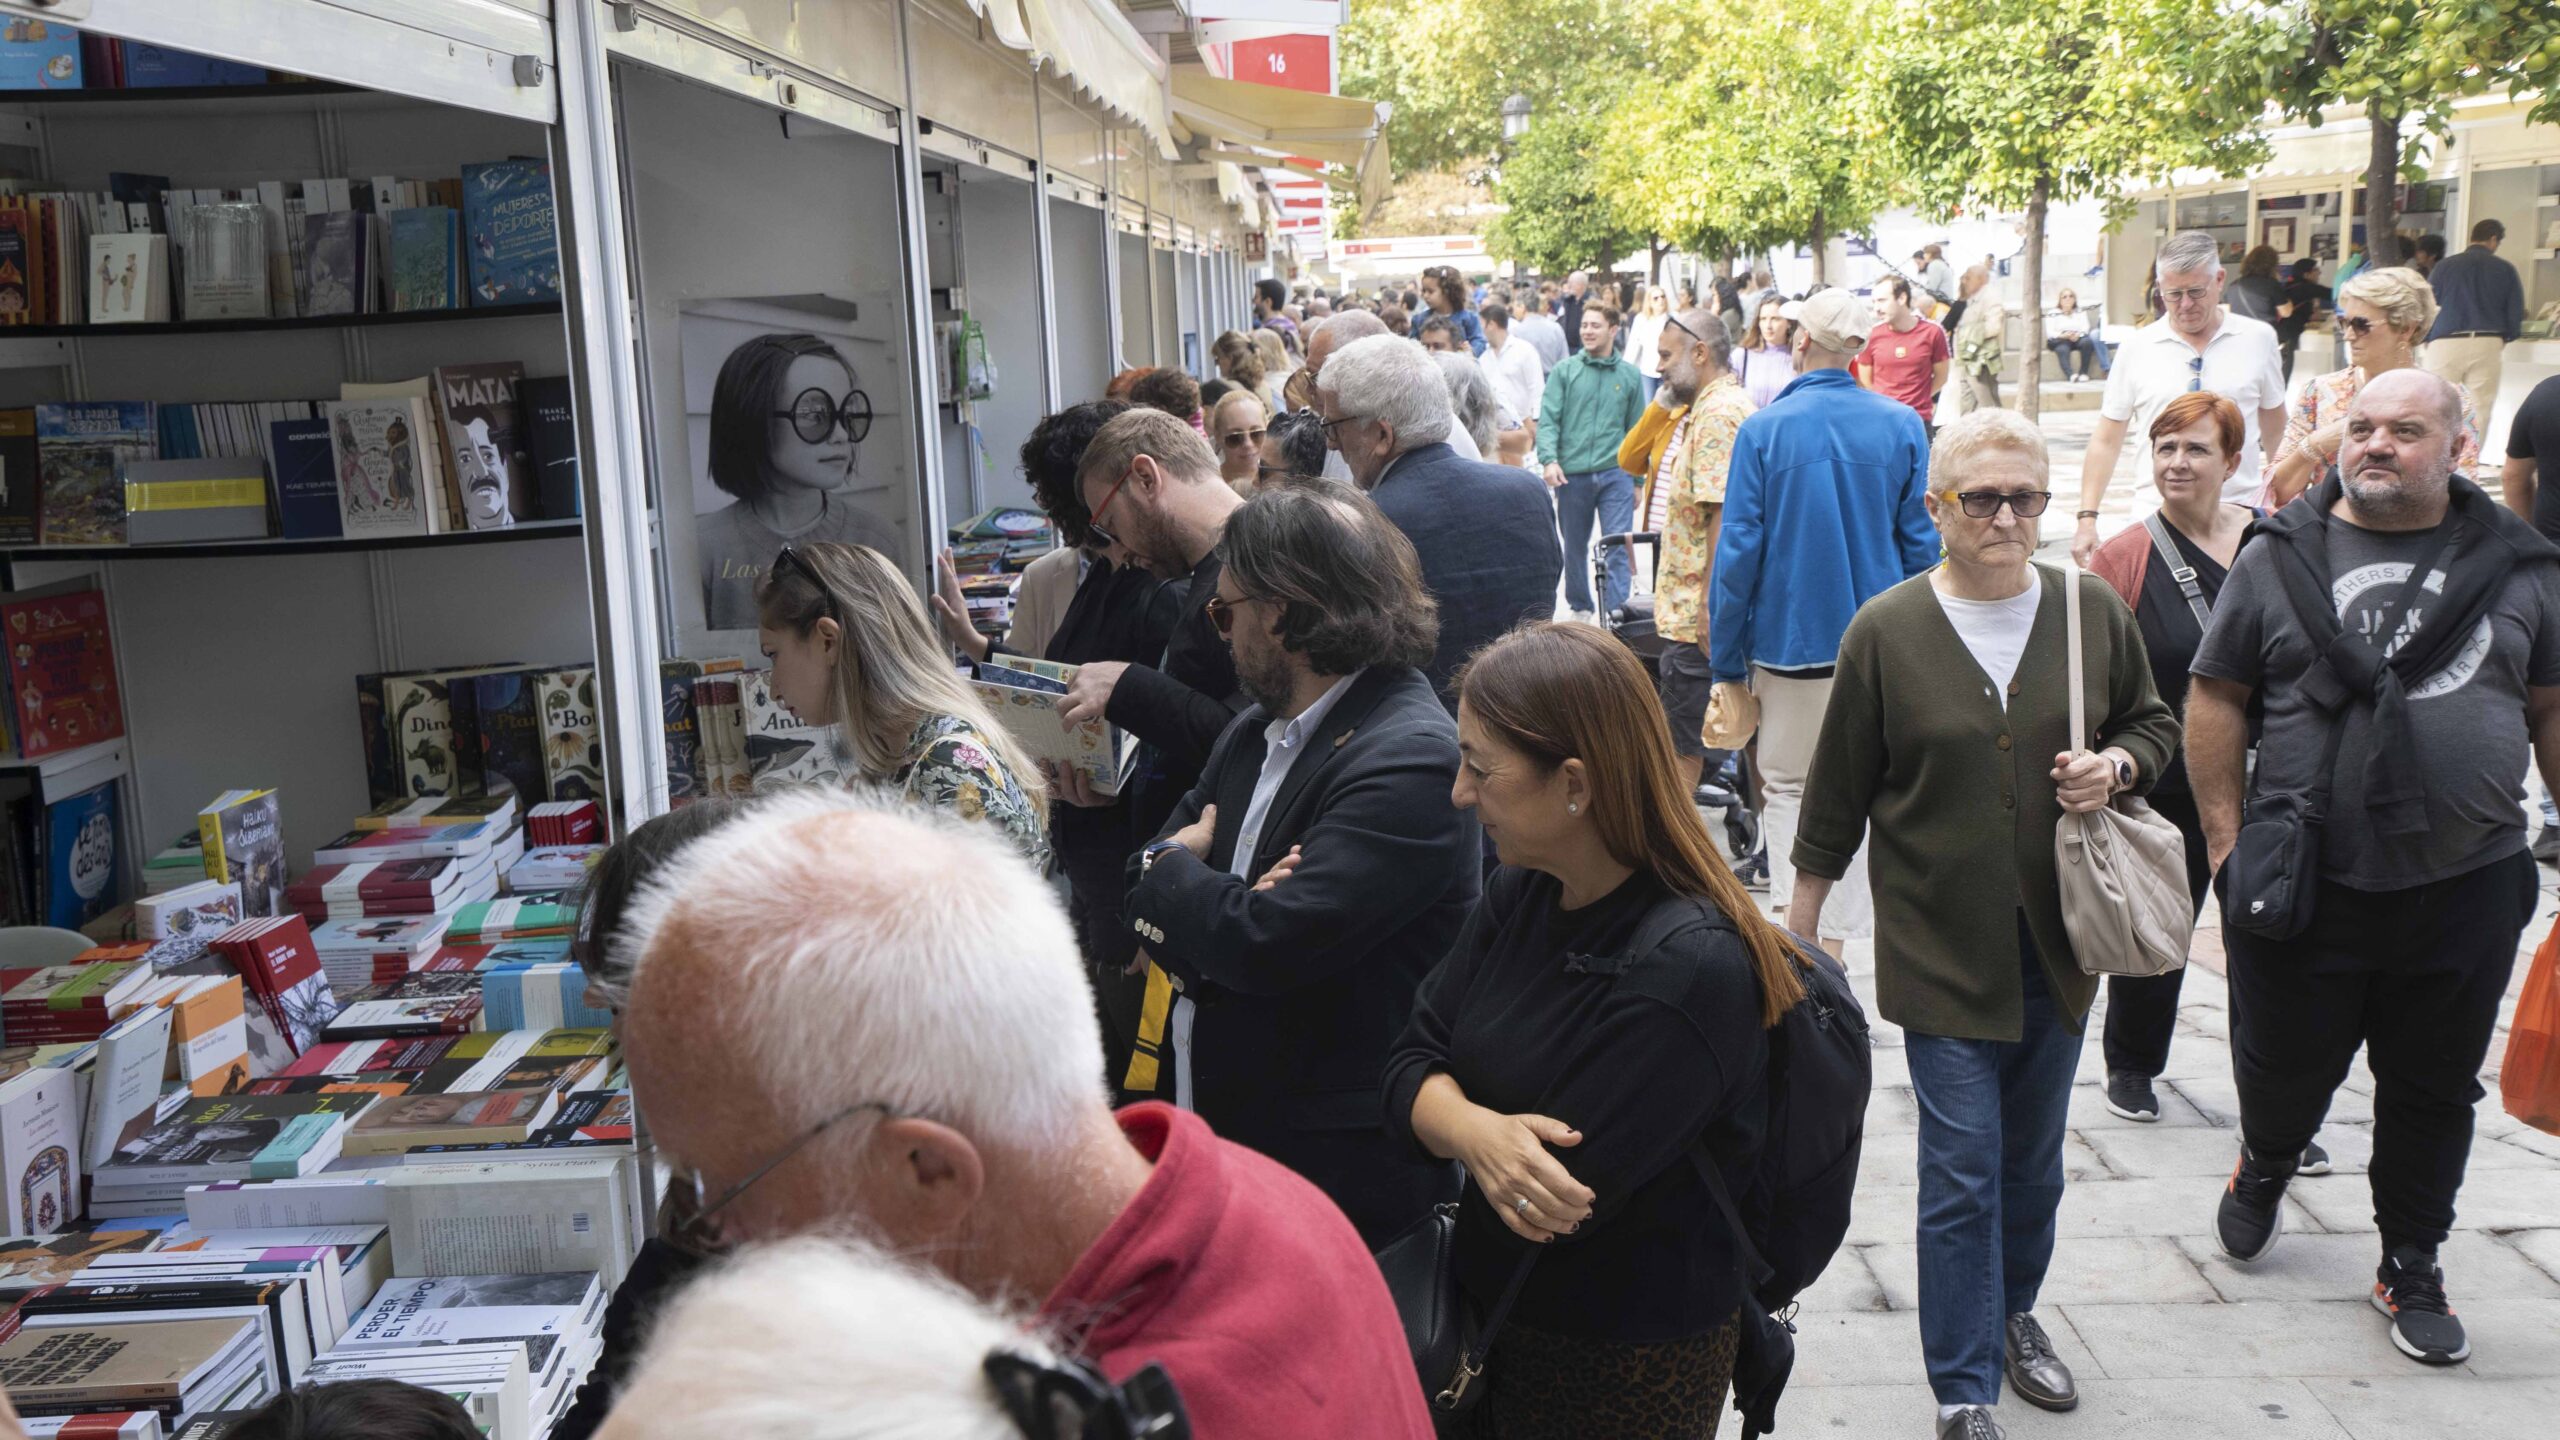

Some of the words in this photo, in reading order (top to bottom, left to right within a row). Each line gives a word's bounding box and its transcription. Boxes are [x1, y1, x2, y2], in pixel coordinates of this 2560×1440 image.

[1268, 53, 1286, 74] 16
[493, 193, 542, 217] MUJERES
[721, 558, 761, 579] Las
[2414, 660, 2472, 694] WEAR
[411, 716, 453, 734] Din
[561, 710, 597, 729] Bo
[760, 712, 808, 732] Ani
[564, 1159, 598, 1167] Plath
[355, 1298, 403, 1340] PERDER
[380, 1325, 406, 1338] EL
[393, 1281, 437, 1324] TIEMPO
[336, 1363, 368, 1371] Woolf
